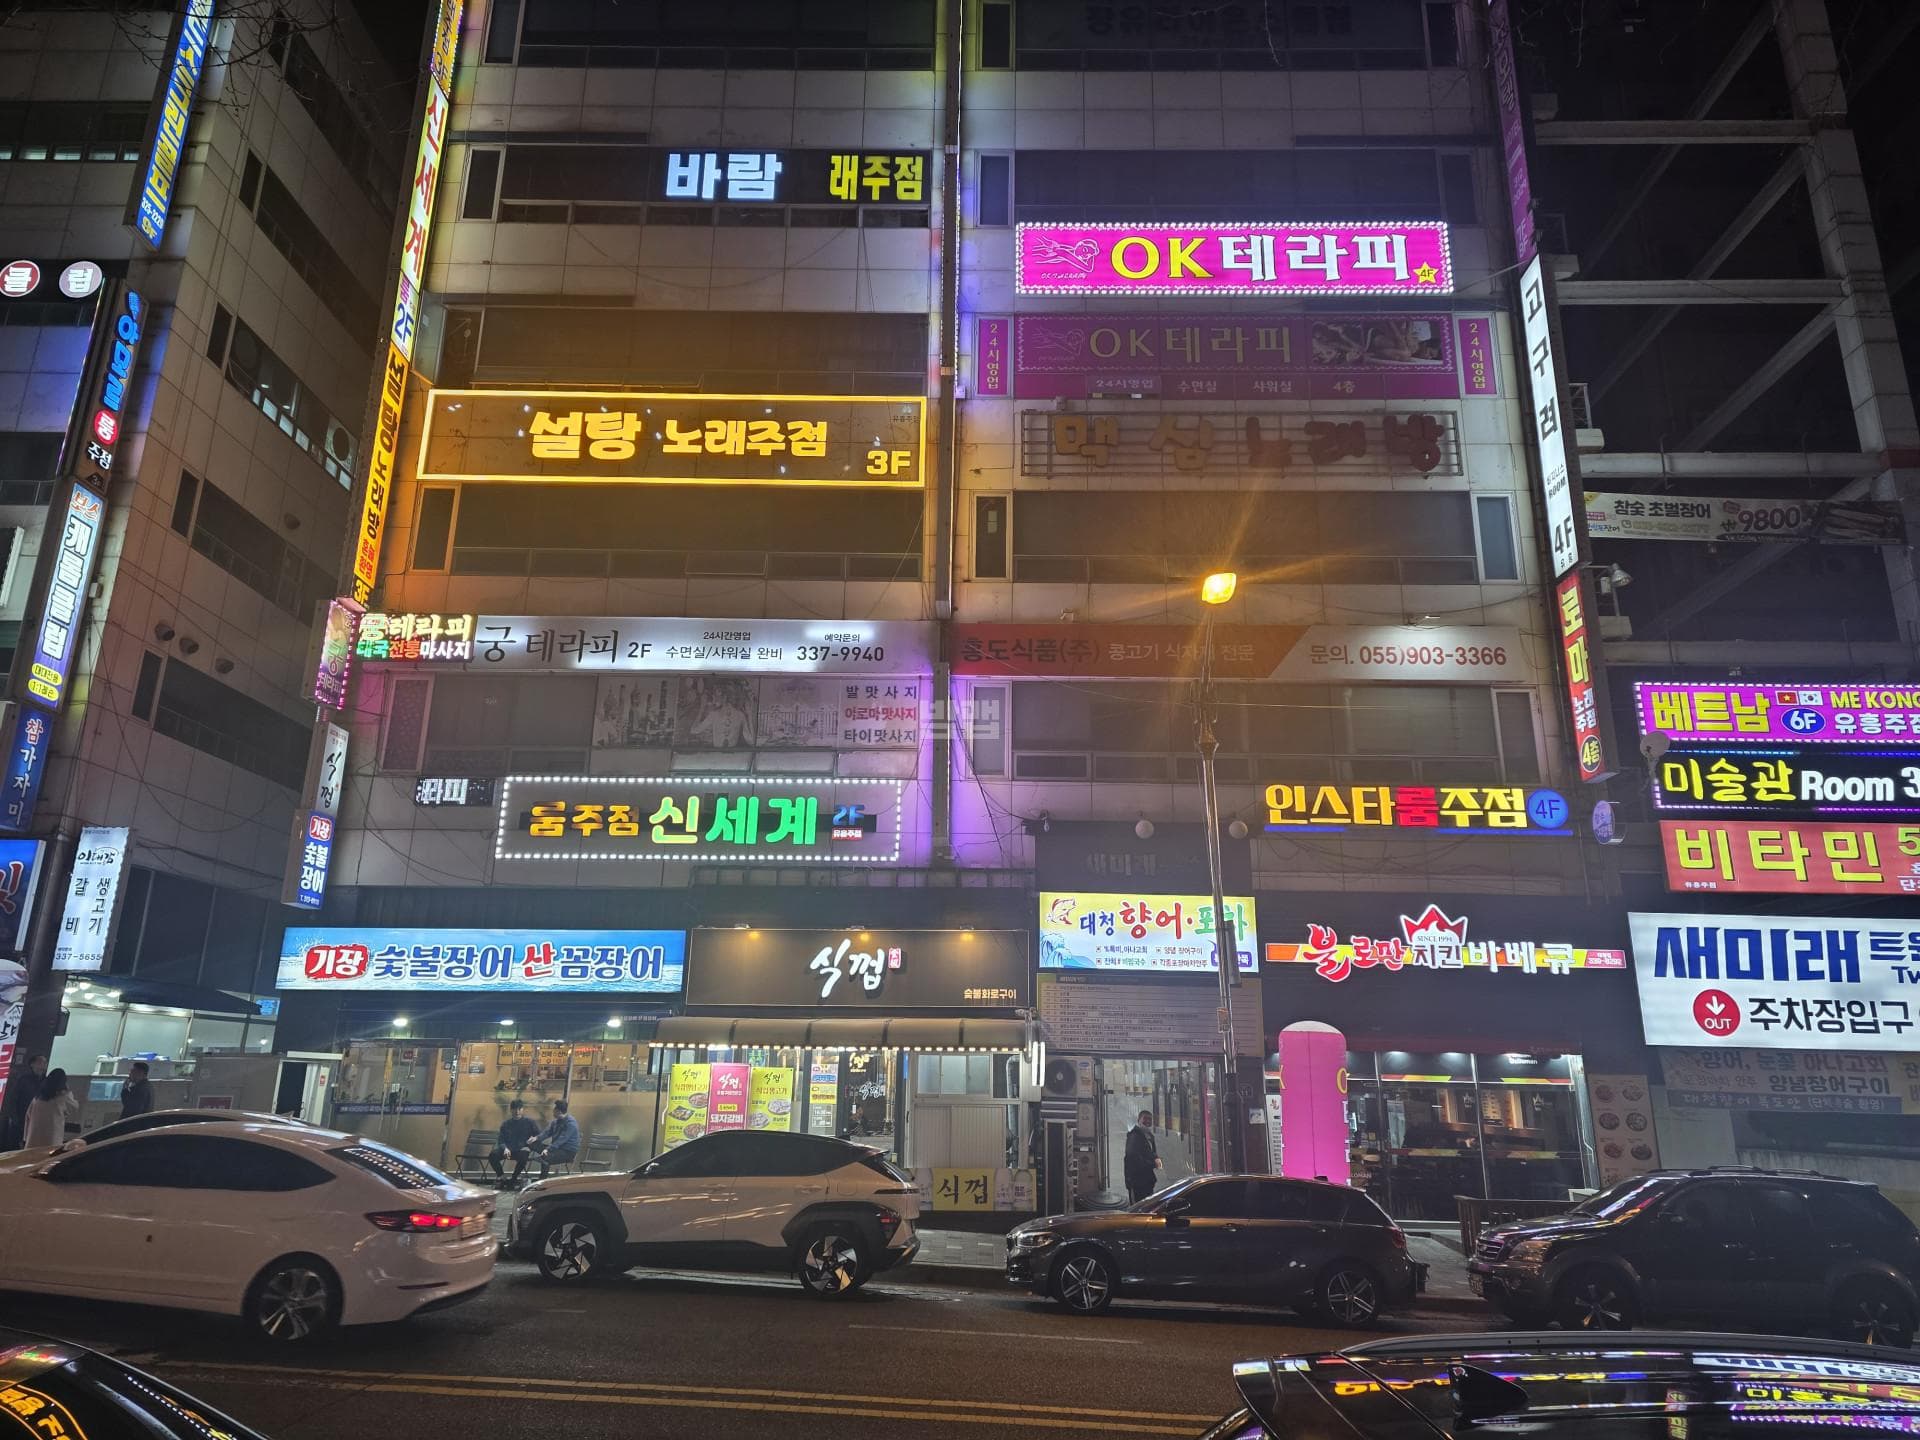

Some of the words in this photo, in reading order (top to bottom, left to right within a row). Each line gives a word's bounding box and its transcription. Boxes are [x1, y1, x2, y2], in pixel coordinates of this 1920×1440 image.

[405, 94, 445, 280] 신세계
[666, 153, 782, 199] 바람
[829, 155, 923, 200] 래주점
[1110, 236, 1214, 279] OK
[1218, 234, 1410, 282] 테라피
[394, 303, 414, 342] 2F
[1089, 328, 1155, 358] OK
[1166, 327, 1290, 363] 테라피
[1525, 278, 1557, 441] 고구려
[1096, 379, 1153, 389] 24시영업
[1177, 380, 1217, 392] 수면실
[529, 411, 641, 460] 설탕
[663, 419, 827, 457] 노래주점
[866, 450, 911, 476] 3F
[1614, 500, 1645, 517] 참숯
[1649, 500, 1711, 519] 초벌장어
[1554, 517, 1572, 554] 4F
[477, 626, 516, 662] 궁
[526, 629, 618, 664] 테라피
[627, 642, 652, 658] 2F
[703, 631, 751, 641] 24시간영업
[825, 633, 860, 642] 예약문의
[1561, 586, 1590, 683] 로마
[758, 648, 783, 660] 완비
[797, 646, 884, 662] 337-9940
[1360, 646, 1507, 666] 055)903-3366
[845, 705, 918, 722] 아로마맛사지
[1651, 691, 1771, 733] 베트남
[1790, 711, 1818, 731] 6F
[844, 728, 917, 744] 타이맛사지
[8, 718, 43, 826] 참가자미
[321, 752, 341, 808] 식껍
[1662, 758, 1796, 801] 미술관
[1801, 770, 1894, 801] Room
[649, 796, 818, 844] 신세계
[833, 804, 865, 825] 2F
[1534, 798, 1560, 818] 4F
[313, 817, 330, 838] 기장
[1675, 829, 1884, 882] 비타민
[301, 866, 324, 894] 장어
[1080, 911, 1114, 936] 대청
[55, 952, 101, 961] 337-5655
[310, 947, 364, 976] 기장
[374, 945, 513, 979] 숯불장어
[524, 943, 556, 978] 산
[560, 946, 663, 980] 꼼장어
[810, 938, 884, 999] 식껍
[1654, 927, 1861, 983] 새미래
[964, 989, 1016, 1000] 숯불화로구이
[1704, 1018, 1731, 1030] OUT
[1748, 998, 1913, 1034] 주차장입구
[719, 1073, 739, 1089] 식껍
[937, 1175, 988, 1204] 식껍
